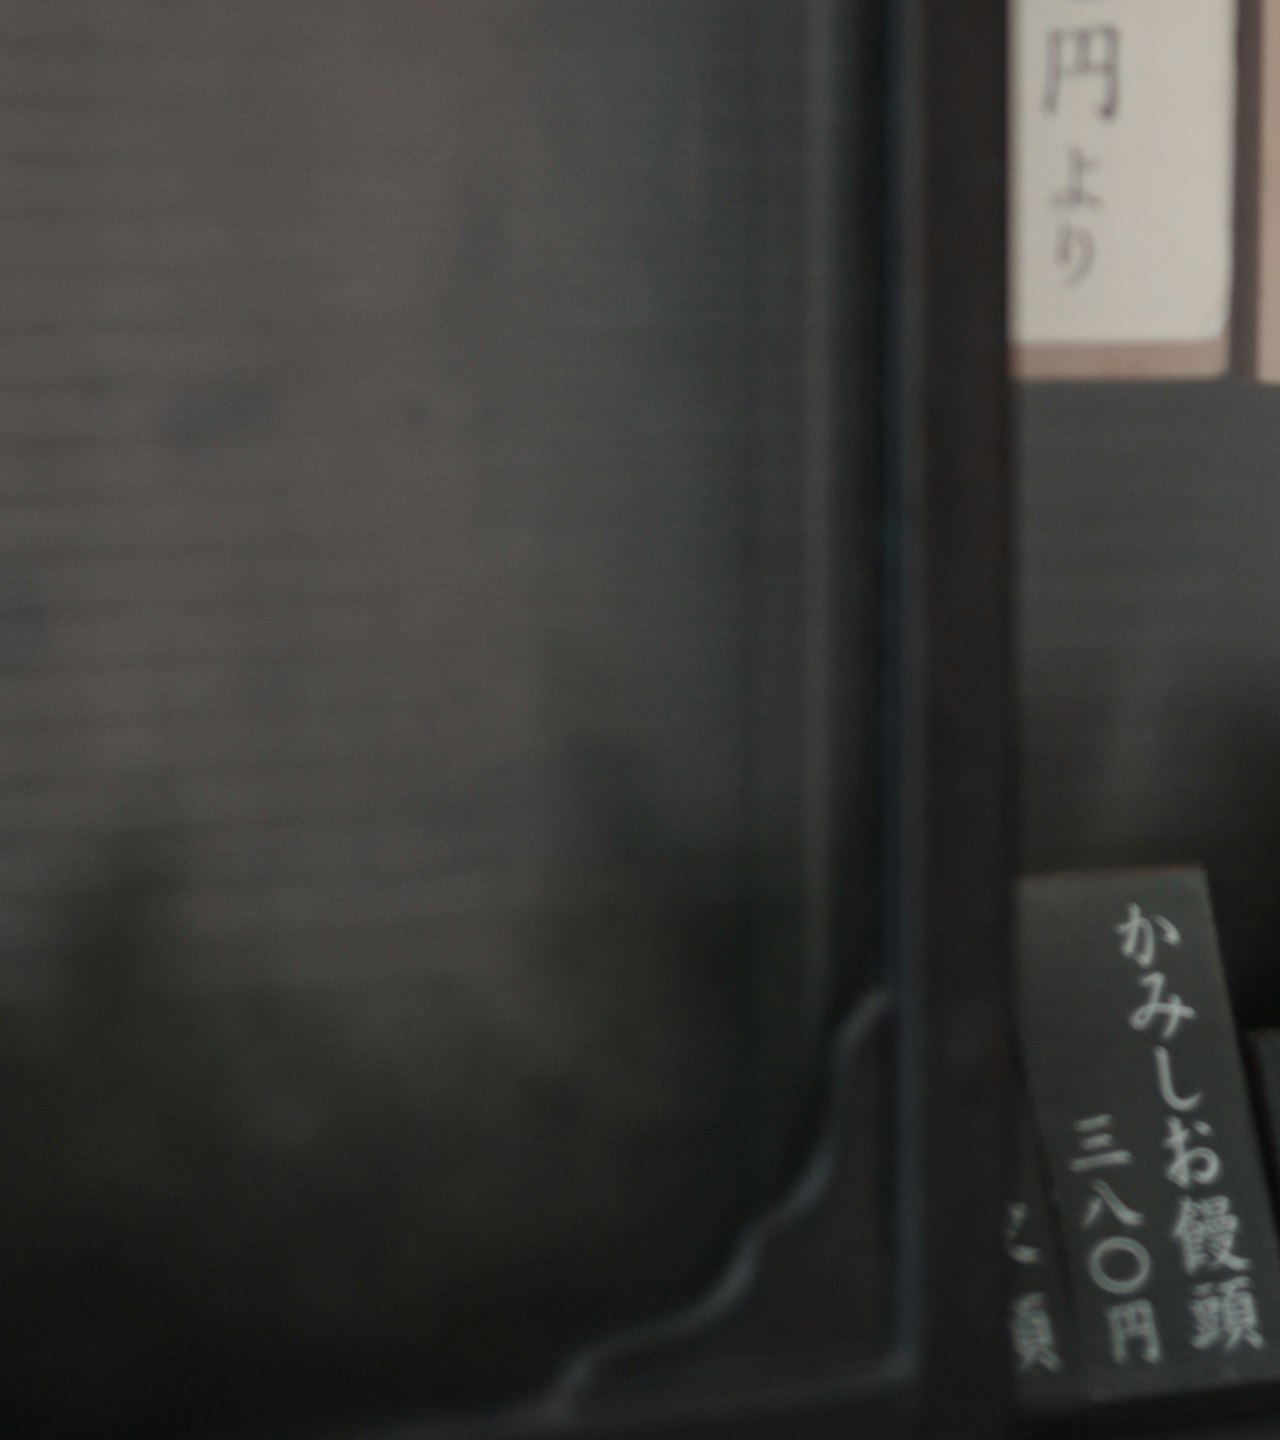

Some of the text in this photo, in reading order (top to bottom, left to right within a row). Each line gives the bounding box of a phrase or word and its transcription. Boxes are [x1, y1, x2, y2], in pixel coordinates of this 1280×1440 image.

[1068, 1114, 1162, 1364] 三八〇円
[1115, 902, 1265, 1352] かみしお饅頭
